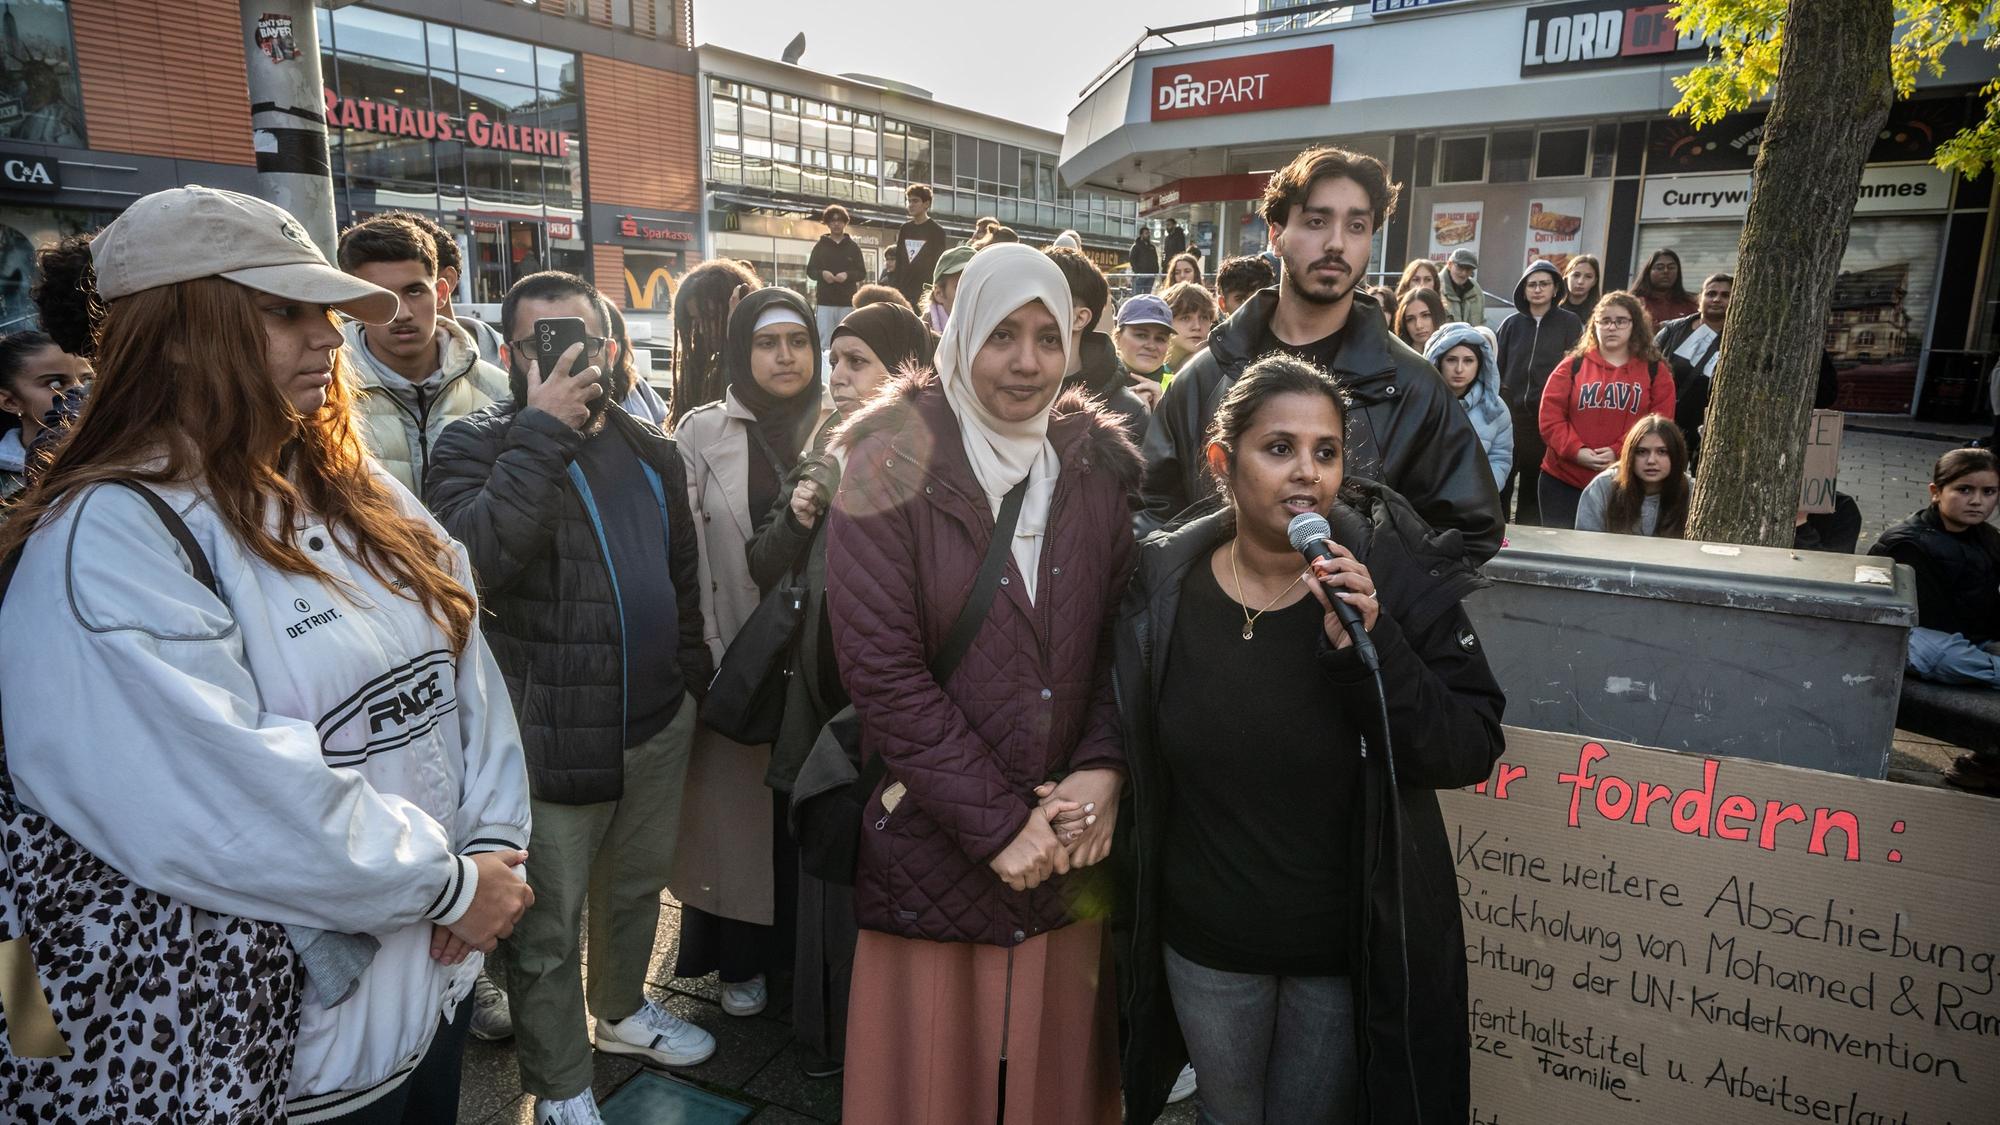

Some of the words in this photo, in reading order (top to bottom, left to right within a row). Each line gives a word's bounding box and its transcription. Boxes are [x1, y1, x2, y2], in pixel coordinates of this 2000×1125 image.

[1524, 10, 1624, 66] LORD
[1631, 14, 1668, 47] OF
[324, 88, 570, 157] RATHAUS-GALERIE
[1159, 74, 1270, 111] DERPART
[4, 159, 55, 185] C&A
[1663, 188, 1749, 208] Curryw
[1857, 181, 1927, 199] mmes
[642, 226, 694, 241] Sparkasse
[1803, 477, 1837, 507] ION
[286, 608, 343, 640] DETROIT.
[367, 671, 443, 735] RACE
[1557, 741, 1861, 862] fordern
[1456, 824, 1551, 882] Keine
[1562, 854, 1684, 907] weitere
[1704, 875, 2000, 996] Abschiebung
[1637, 933, 1688, 968] von
[1705, 932, 1876, 1011] Mohamed
[1889, 975, 1925, 1021] &
[1464, 936, 1555, 992] chtung
[1572, 960, 1620, 997] der
[1630, 970, 1968, 1084] UN-Kinderkonvention
[1468, 998, 1650, 1077] fenthaltstitel
